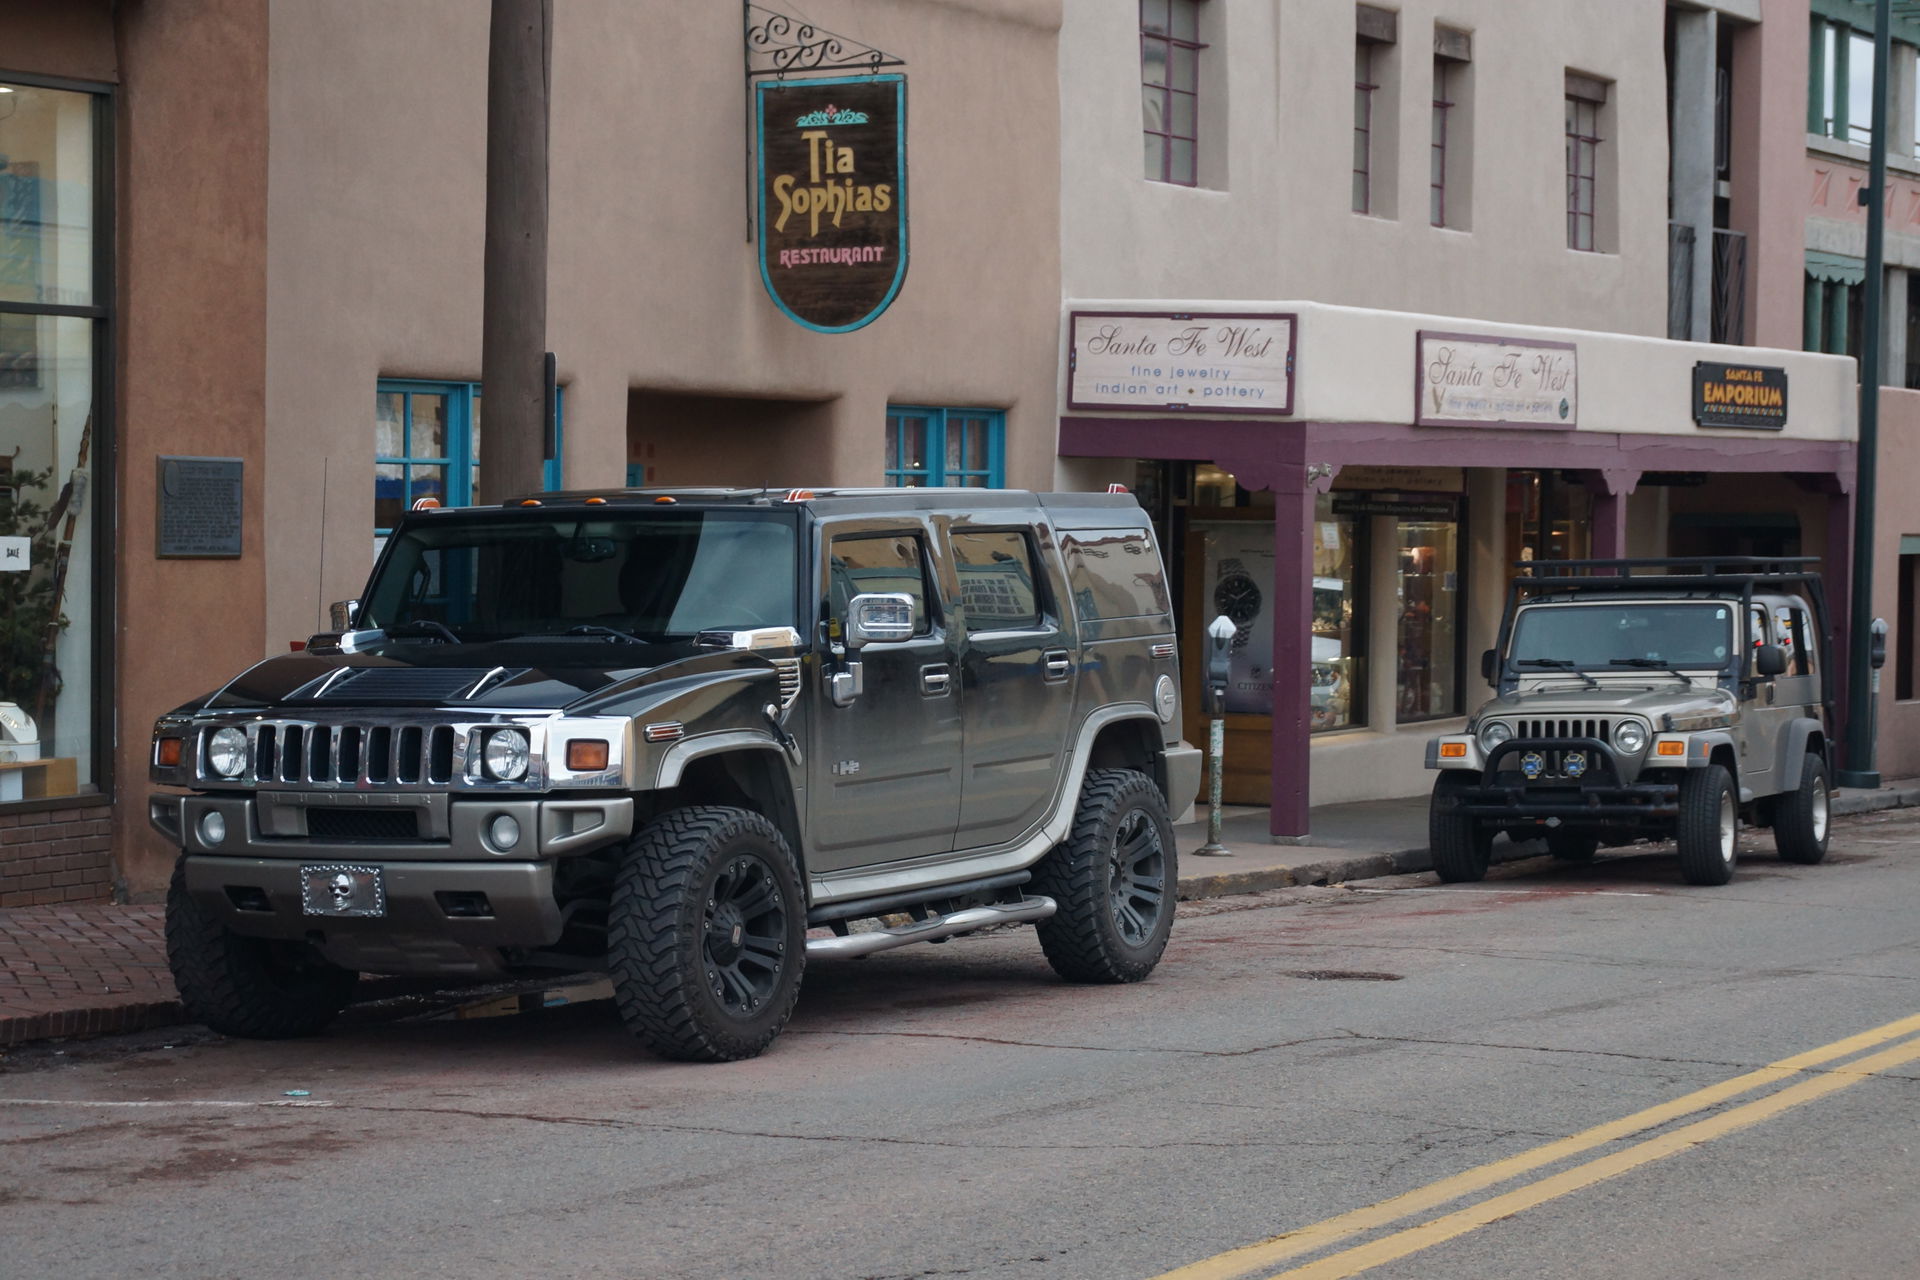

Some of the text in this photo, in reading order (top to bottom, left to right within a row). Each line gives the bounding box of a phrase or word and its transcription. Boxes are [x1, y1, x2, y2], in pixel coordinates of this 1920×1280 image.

[801, 131, 855, 183] Tia
[773, 174, 891, 237] Sophias
[780, 246, 885, 269] RESTAURANT
[1088, 325, 1273, 358] Santa Fe West
[1131, 365, 1231, 380] fine jewelry
[1429, 346, 1570, 391] Santa Fe West
[1725, 368, 1763, 382] SANTA FE
[1095, 382, 1265, 399] indian art pottery
[1703, 381, 1783, 406] EMPORIUM
[7, 547, 20, 558] SALE
